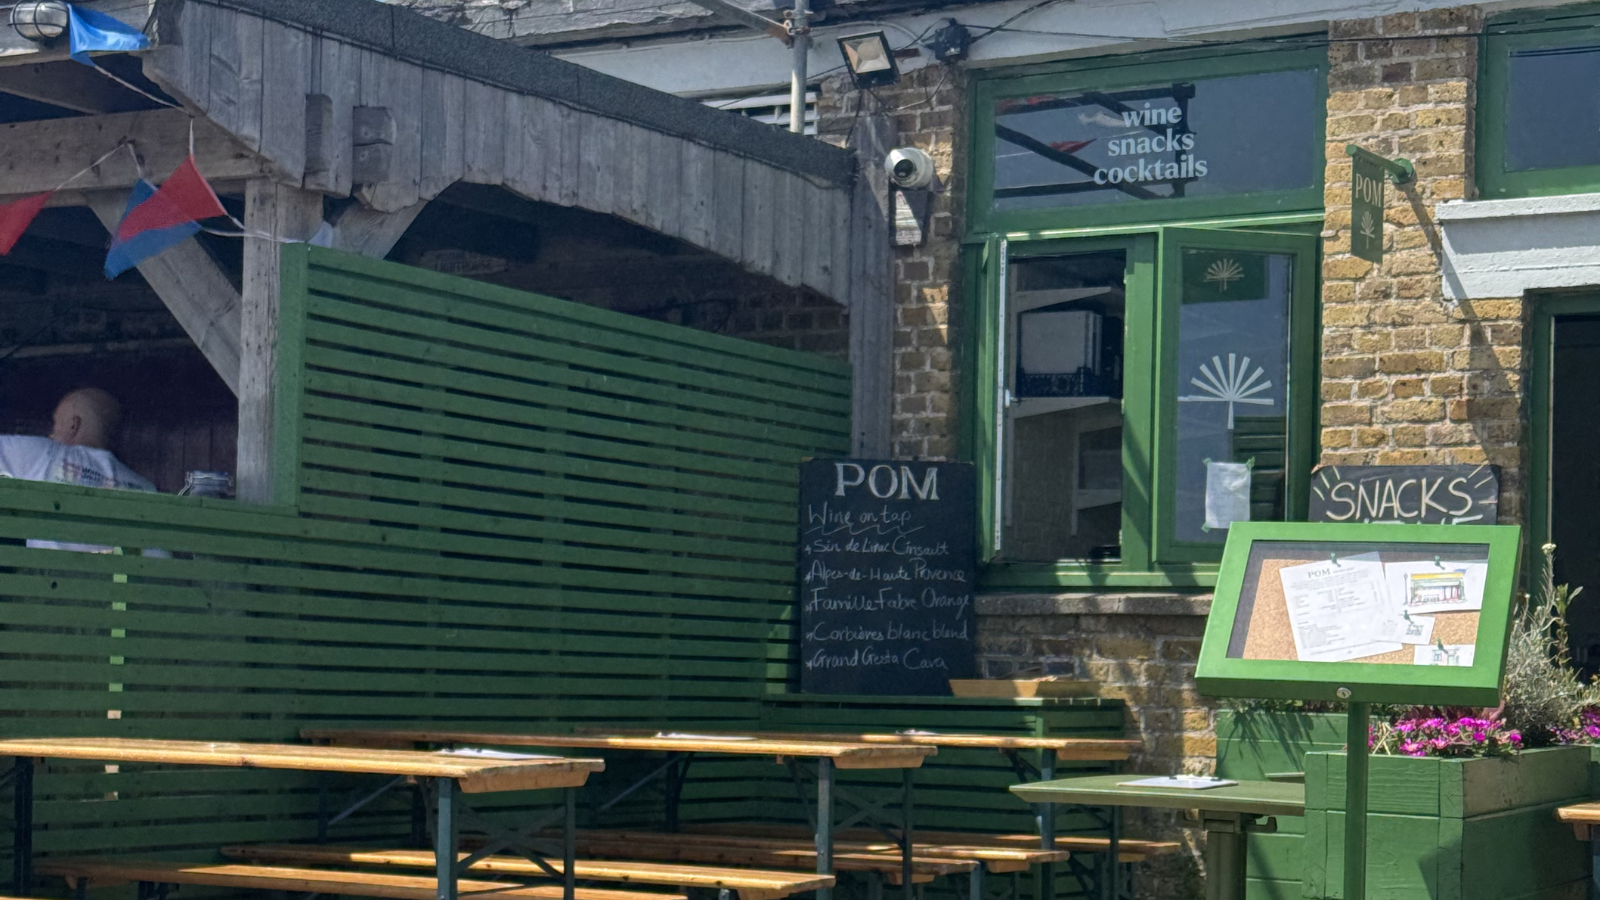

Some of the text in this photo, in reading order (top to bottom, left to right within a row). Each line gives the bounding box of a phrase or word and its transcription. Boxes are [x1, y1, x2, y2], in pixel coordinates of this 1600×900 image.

[1122, 102, 1182, 127] wine
[1108, 128, 1194, 156] snacks
[1094, 154, 1208, 184] cocktails
[1355, 173, 1382, 207] POM
[835, 463, 939, 499] POM
[1326, 476, 1473, 520] SNACKS
[808, 502, 911, 526] Wine on tap
[846, 538, 860, 552] de
[892, 535, 949, 555] Cinsault
[909, 557, 966, 582] Provence
[1308, 568, 1331, 579] POM
[809, 587, 878, 611] Famille
[921, 587, 969, 620] Orange
[887, 621, 931, 641] blanc
[932, 619, 969, 640] blend
[813, 646, 949, 670] Grand Gesta Cava
